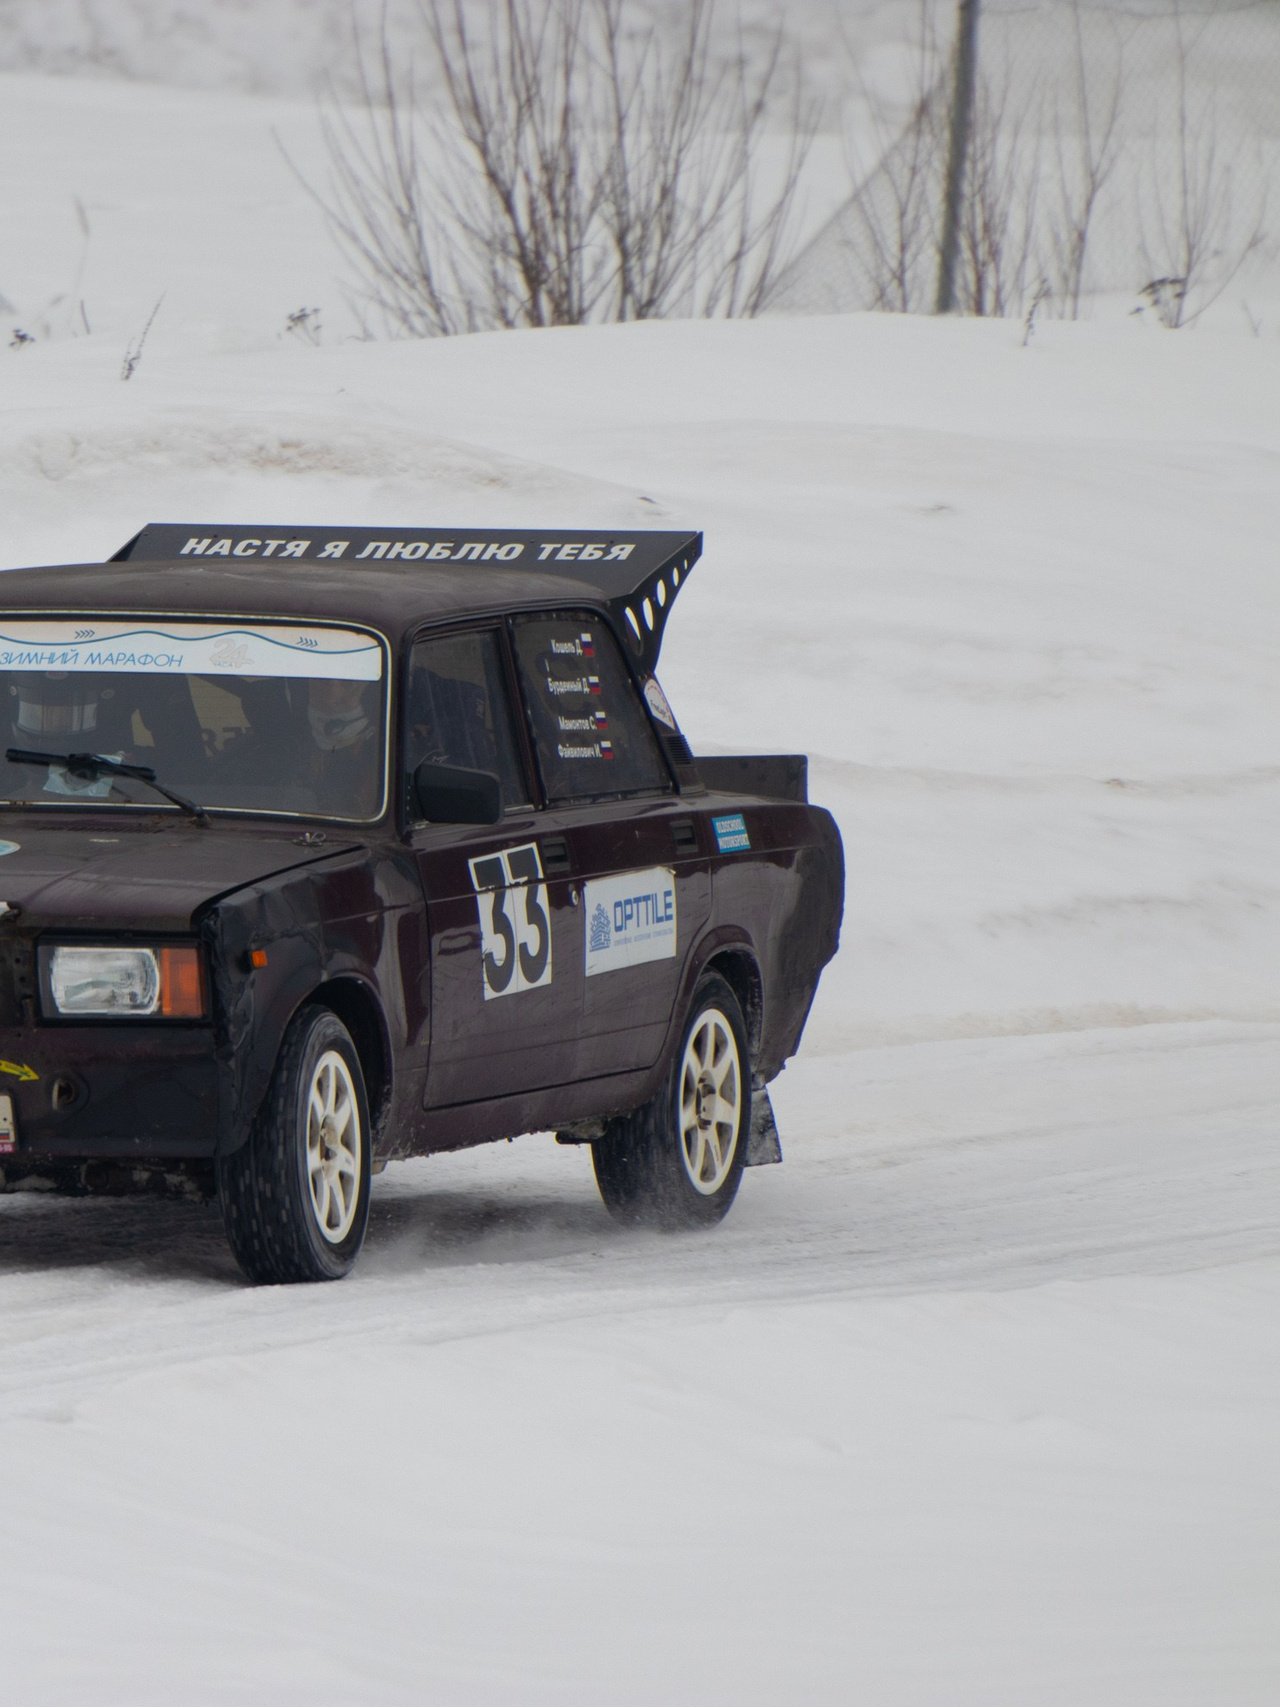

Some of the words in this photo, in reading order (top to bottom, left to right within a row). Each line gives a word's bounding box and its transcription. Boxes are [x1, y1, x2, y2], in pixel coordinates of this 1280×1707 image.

[180, 537, 310, 559] НАСТЯ
[317, 540, 350, 559] Я
[355, 540, 525, 561] ЛЮБЛЮ
[538, 542, 637, 562] ТЕБЯ
[83, 652, 184, 668] МАРАФОН
[716, 818, 744, 833] OLDSCHOOL
[718, 833, 750, 849] MOTORSPORT
[473, 846, 550, 994] 33
[613, 891, 673, 932] OPTTILE
